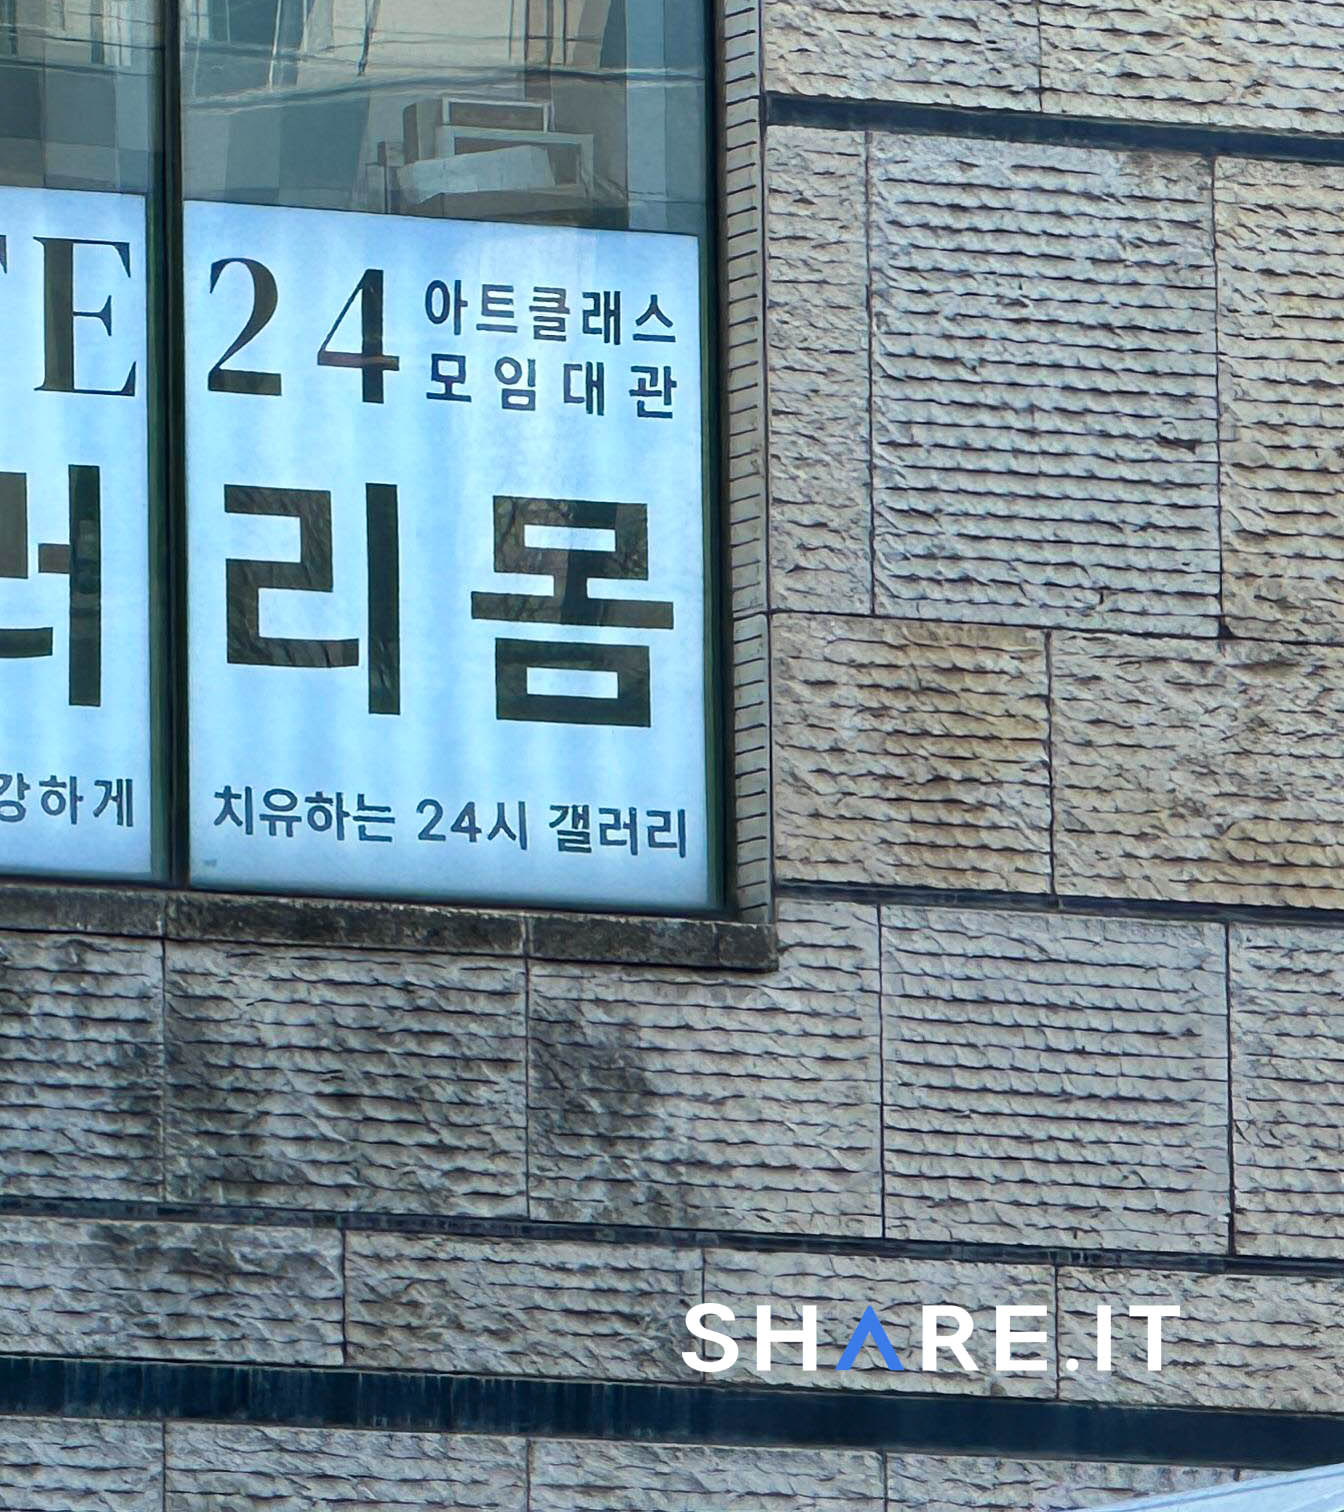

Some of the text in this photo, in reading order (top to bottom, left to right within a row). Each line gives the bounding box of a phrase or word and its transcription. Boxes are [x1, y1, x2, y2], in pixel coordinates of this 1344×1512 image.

[208, 257, 399, 404] 24
[426, 279, 676, 345] 아트클래스
[213, 785, 396, 843] 치유하는
[416, 799, 528, 850] 24시
[548, 804, 687, 858] 갤러리
